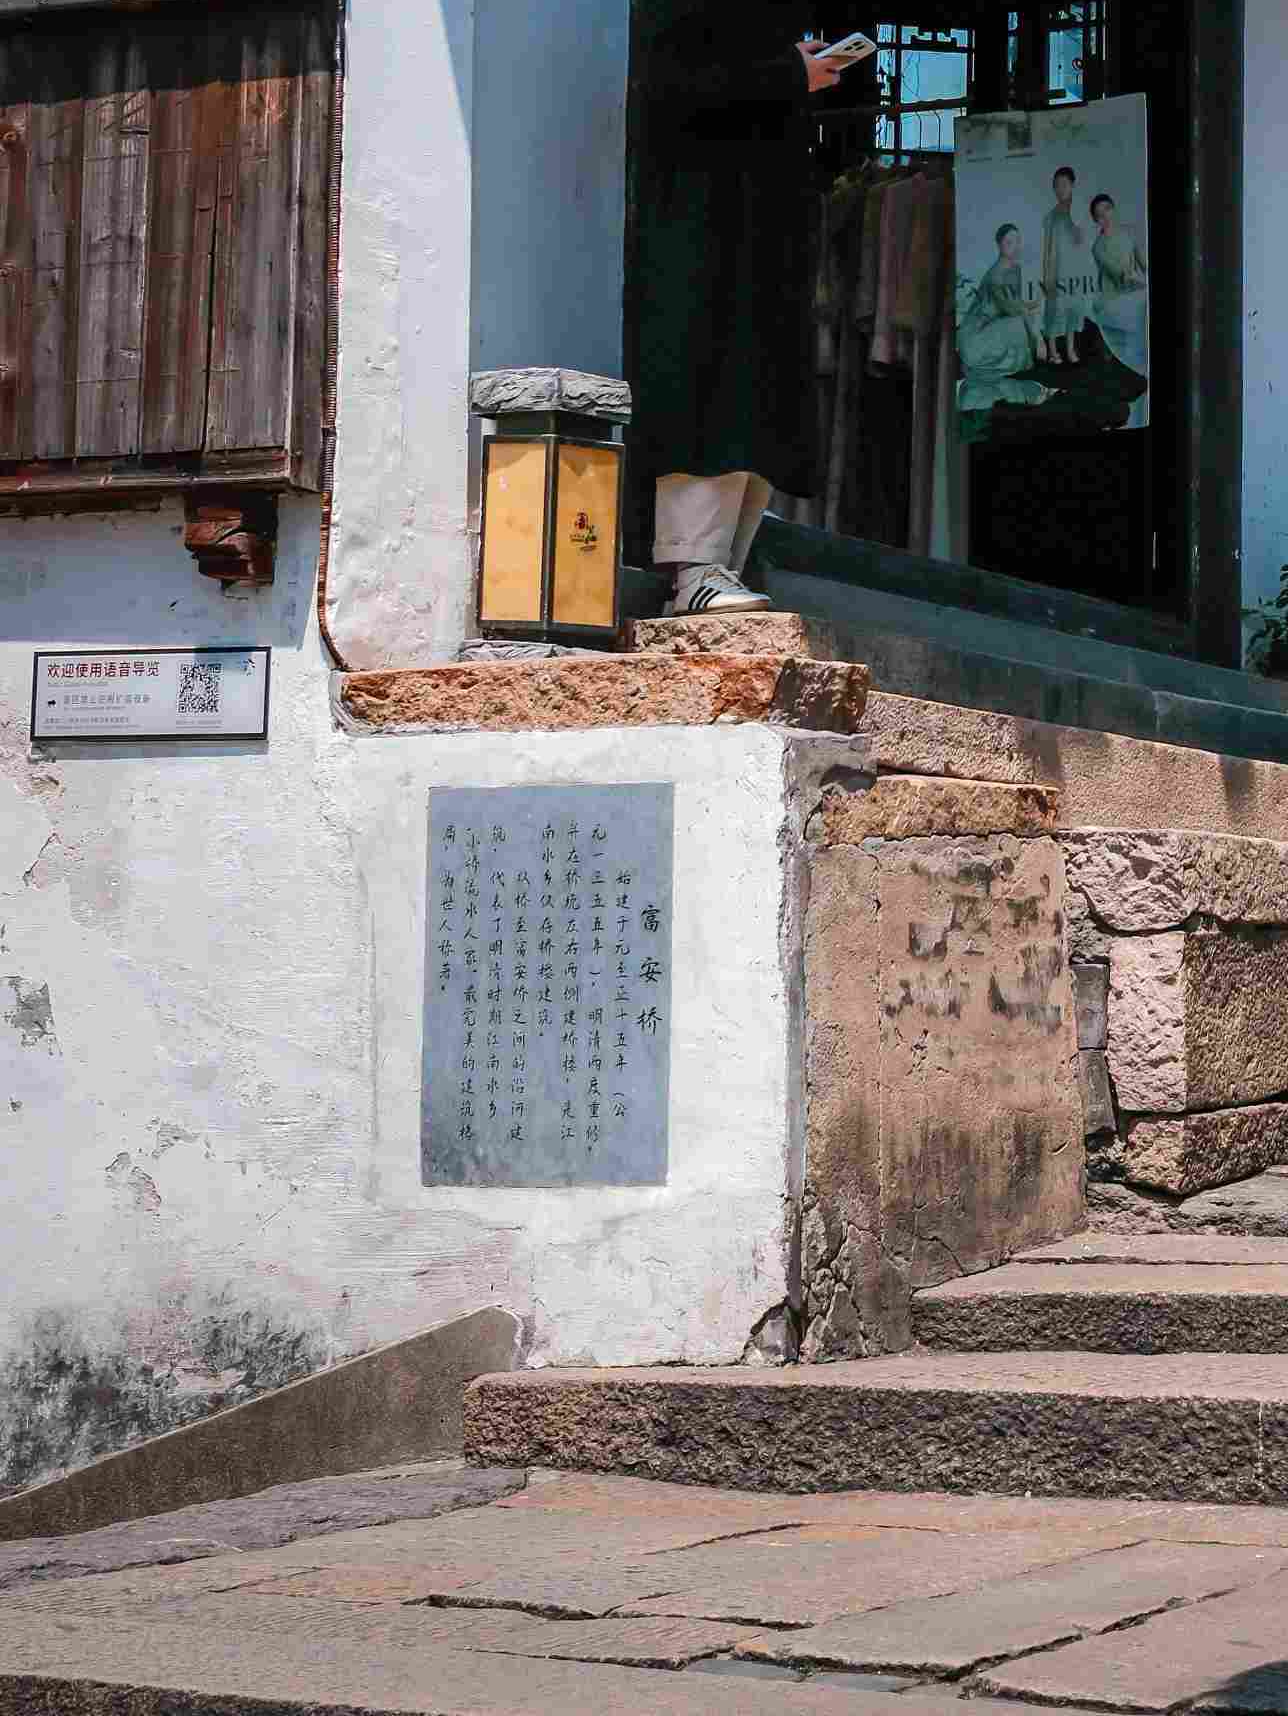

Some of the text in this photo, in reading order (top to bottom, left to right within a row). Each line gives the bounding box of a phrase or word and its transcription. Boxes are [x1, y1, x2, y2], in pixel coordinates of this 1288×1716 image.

[47, 660, 161, 679] 欢迎使用语音导览
[637, 904, 664, 1036] 富安桥
